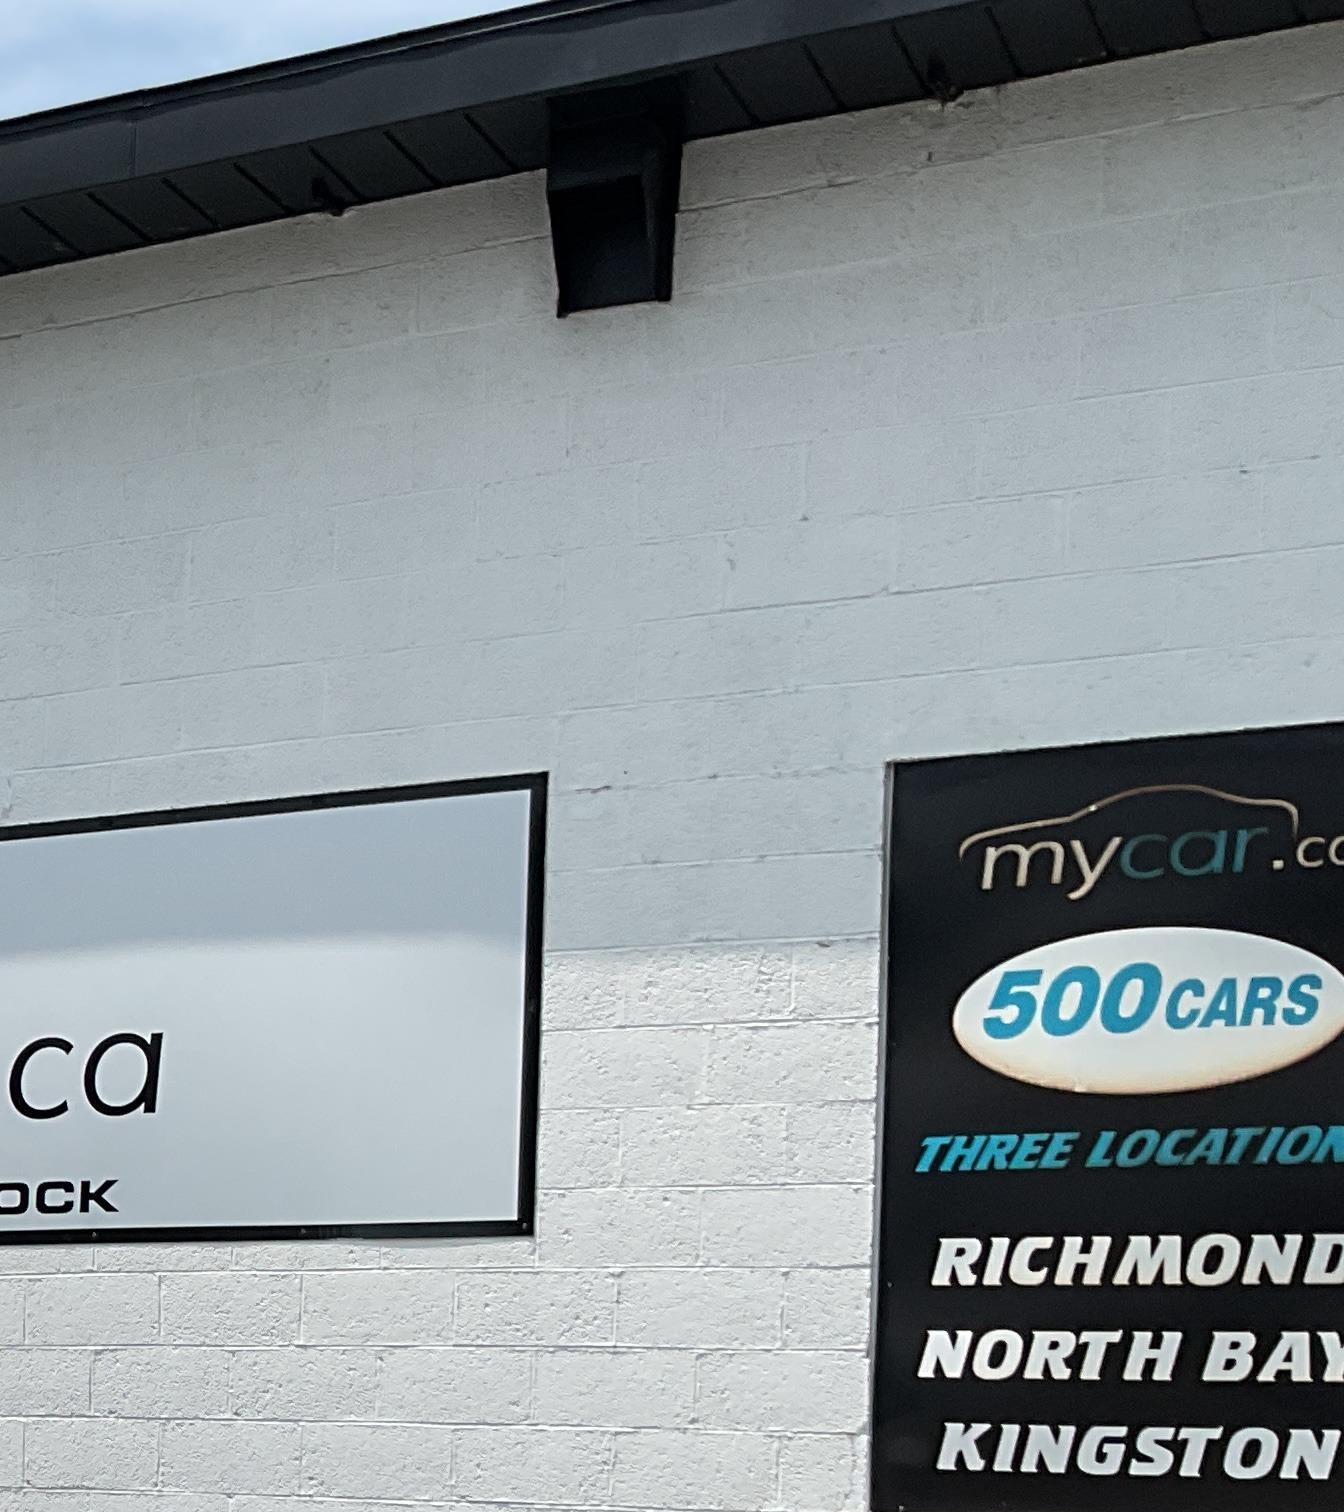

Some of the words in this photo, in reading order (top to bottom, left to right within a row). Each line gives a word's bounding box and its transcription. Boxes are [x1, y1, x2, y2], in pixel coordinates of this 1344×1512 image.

[914, 1130, 1079, 1174] THREE
[930, 1233, 1344, 1288] RICHMOND
[917, 1329, 1184, 1380] NORTH
[936, 1422, 1342, 1480] KINGSTON
